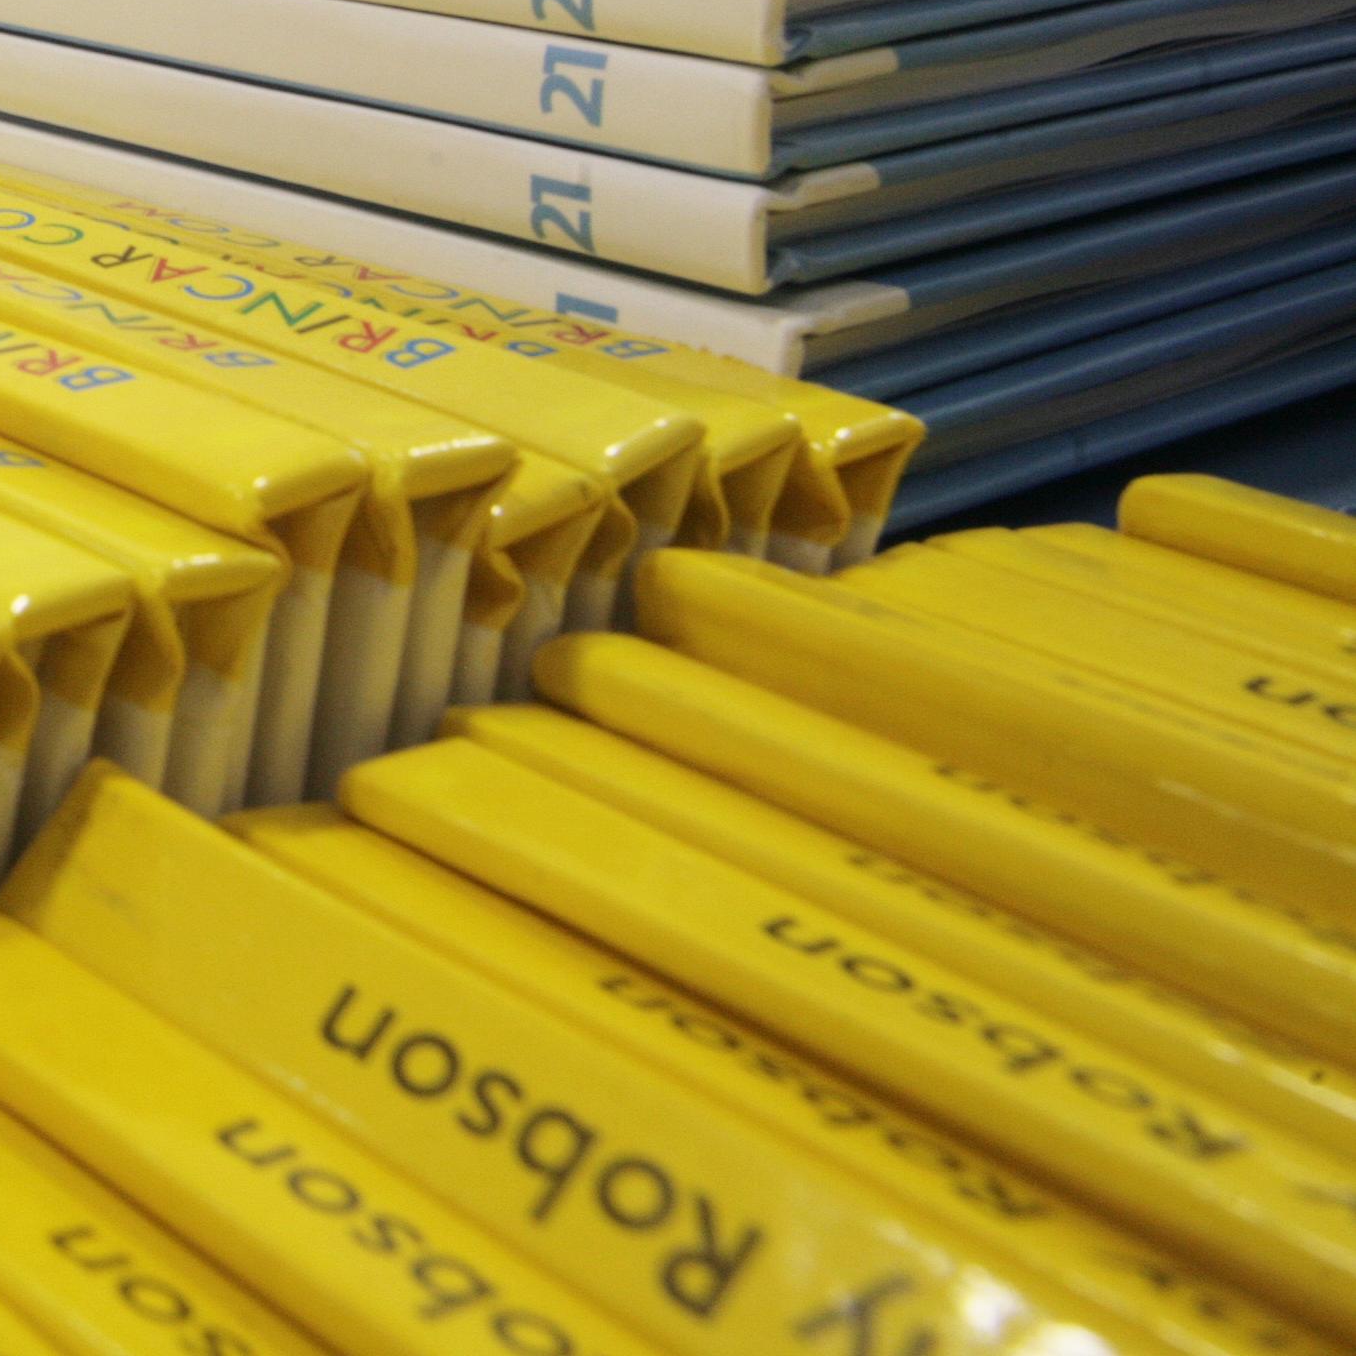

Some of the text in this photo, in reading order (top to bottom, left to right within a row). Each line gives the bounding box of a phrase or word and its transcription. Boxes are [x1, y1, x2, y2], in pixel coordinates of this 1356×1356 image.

[539, 44, 609, 129] 21
[530, 173, 593, 253] 21
[90, 244, 459, 371] BRINCAR
[758, 912, 1250, 1165] Robson
[215, 1115, 587, 1356] obson
[317, 981, 766, 1328] Robson
